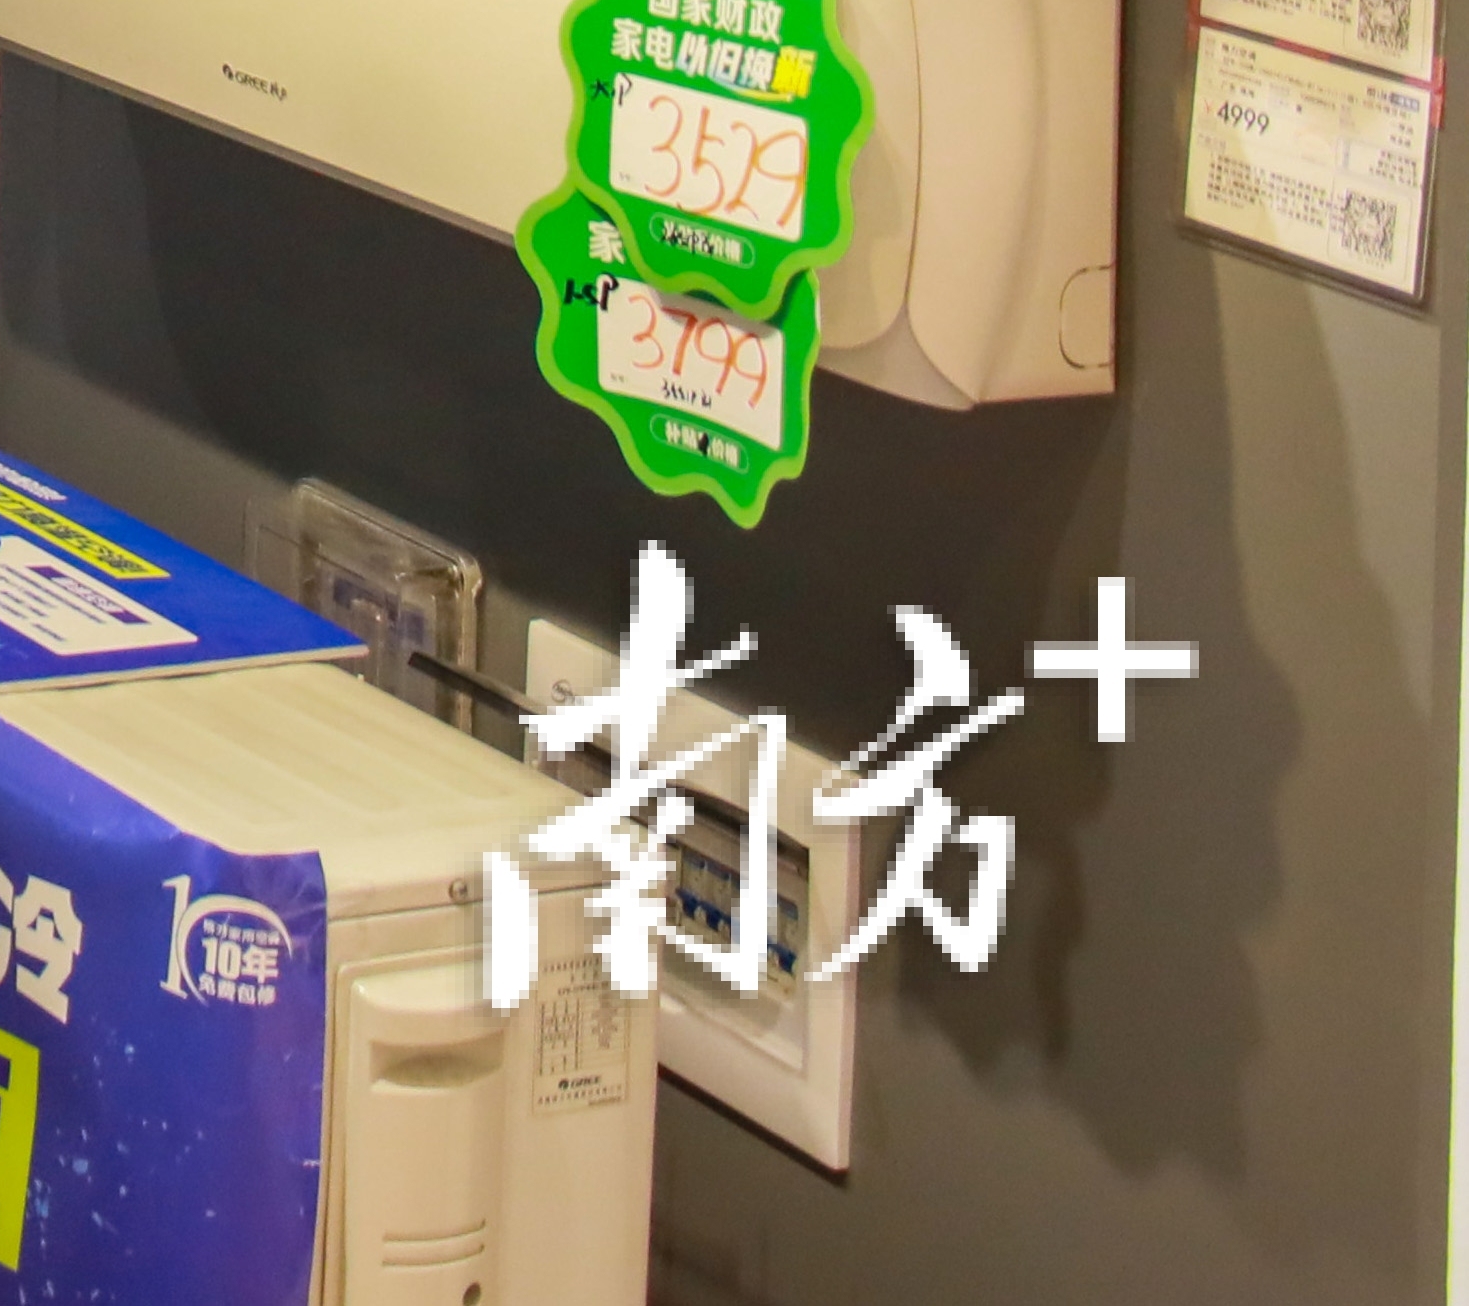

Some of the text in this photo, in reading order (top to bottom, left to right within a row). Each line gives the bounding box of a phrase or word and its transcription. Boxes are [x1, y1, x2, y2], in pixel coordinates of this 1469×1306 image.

[611, 18, 816, 99] 家电以旧换新
[1217, 100, 1270, 135] 4999
[644, 95, 807, 226] 3529
[628, 293, 768, 408] 3799
[203, 936, 278, 984] 10年
